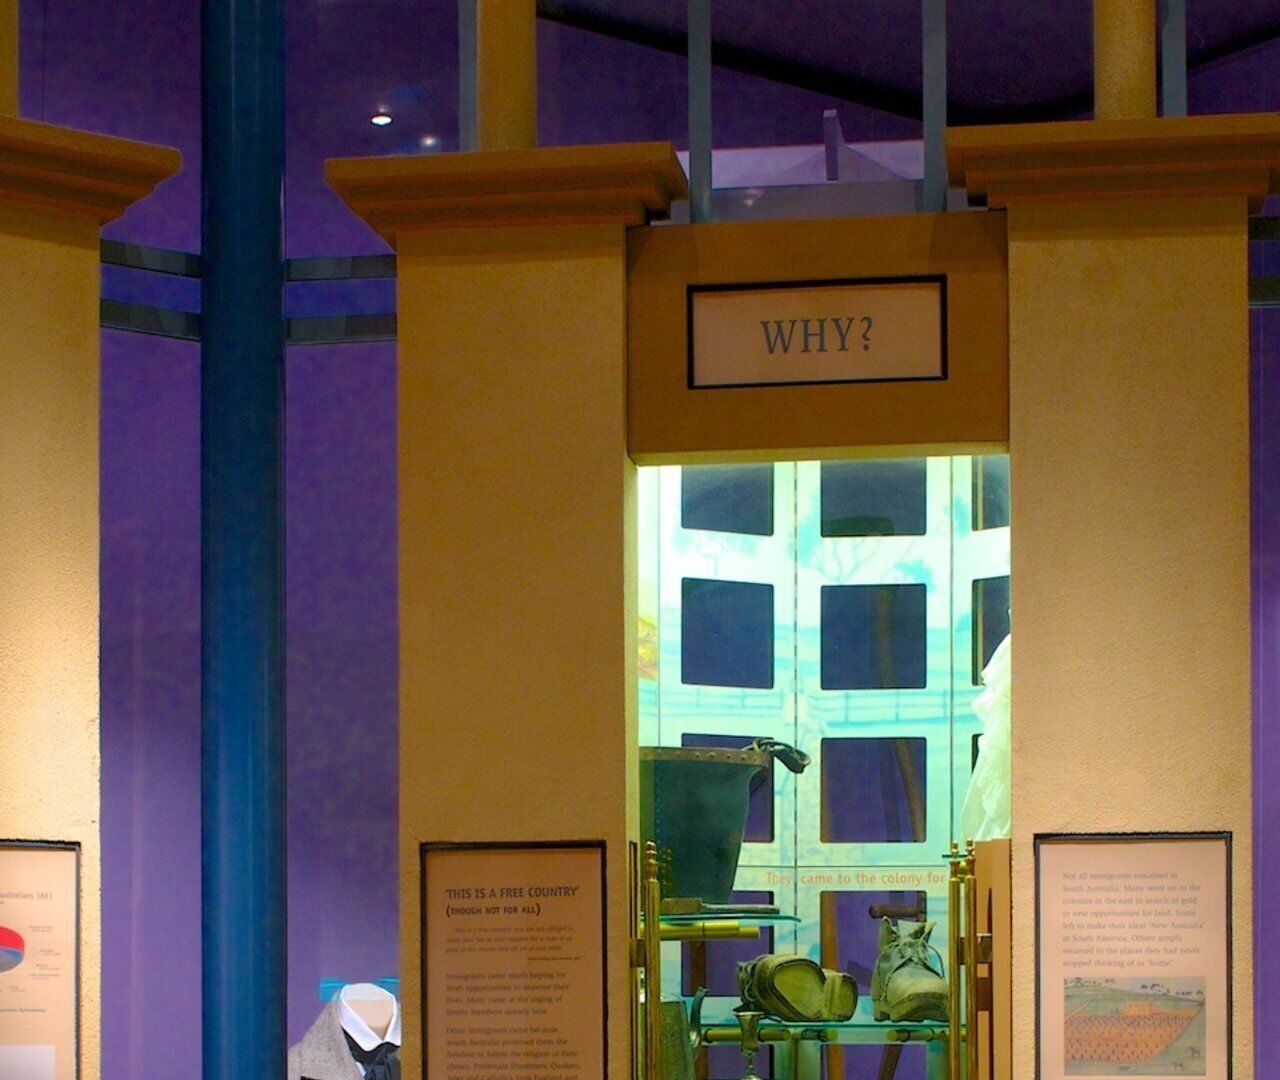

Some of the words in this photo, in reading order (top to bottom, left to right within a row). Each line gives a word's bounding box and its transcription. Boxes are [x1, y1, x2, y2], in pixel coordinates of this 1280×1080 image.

[760, 316, 873, 354] WHY?
[766, 872, 792, 886] They
[801, 874, 833, 885] came
[838, 873, 851, 884] to
[855, 872, 877, 884] the
[881, 872, 922, 888] colony
[927, 872, 945, 884] for
[475, 888, 486, 899] IS
[489, 888, 497, 898] A
[500, 888, 524, 898] FREE
[528, 886, 579, 898] COUNTRY'
[485, 906, 500, 915] NOT
[503, 906, 518, 915] FOR
[521, 903, 541, 916] ALL)
